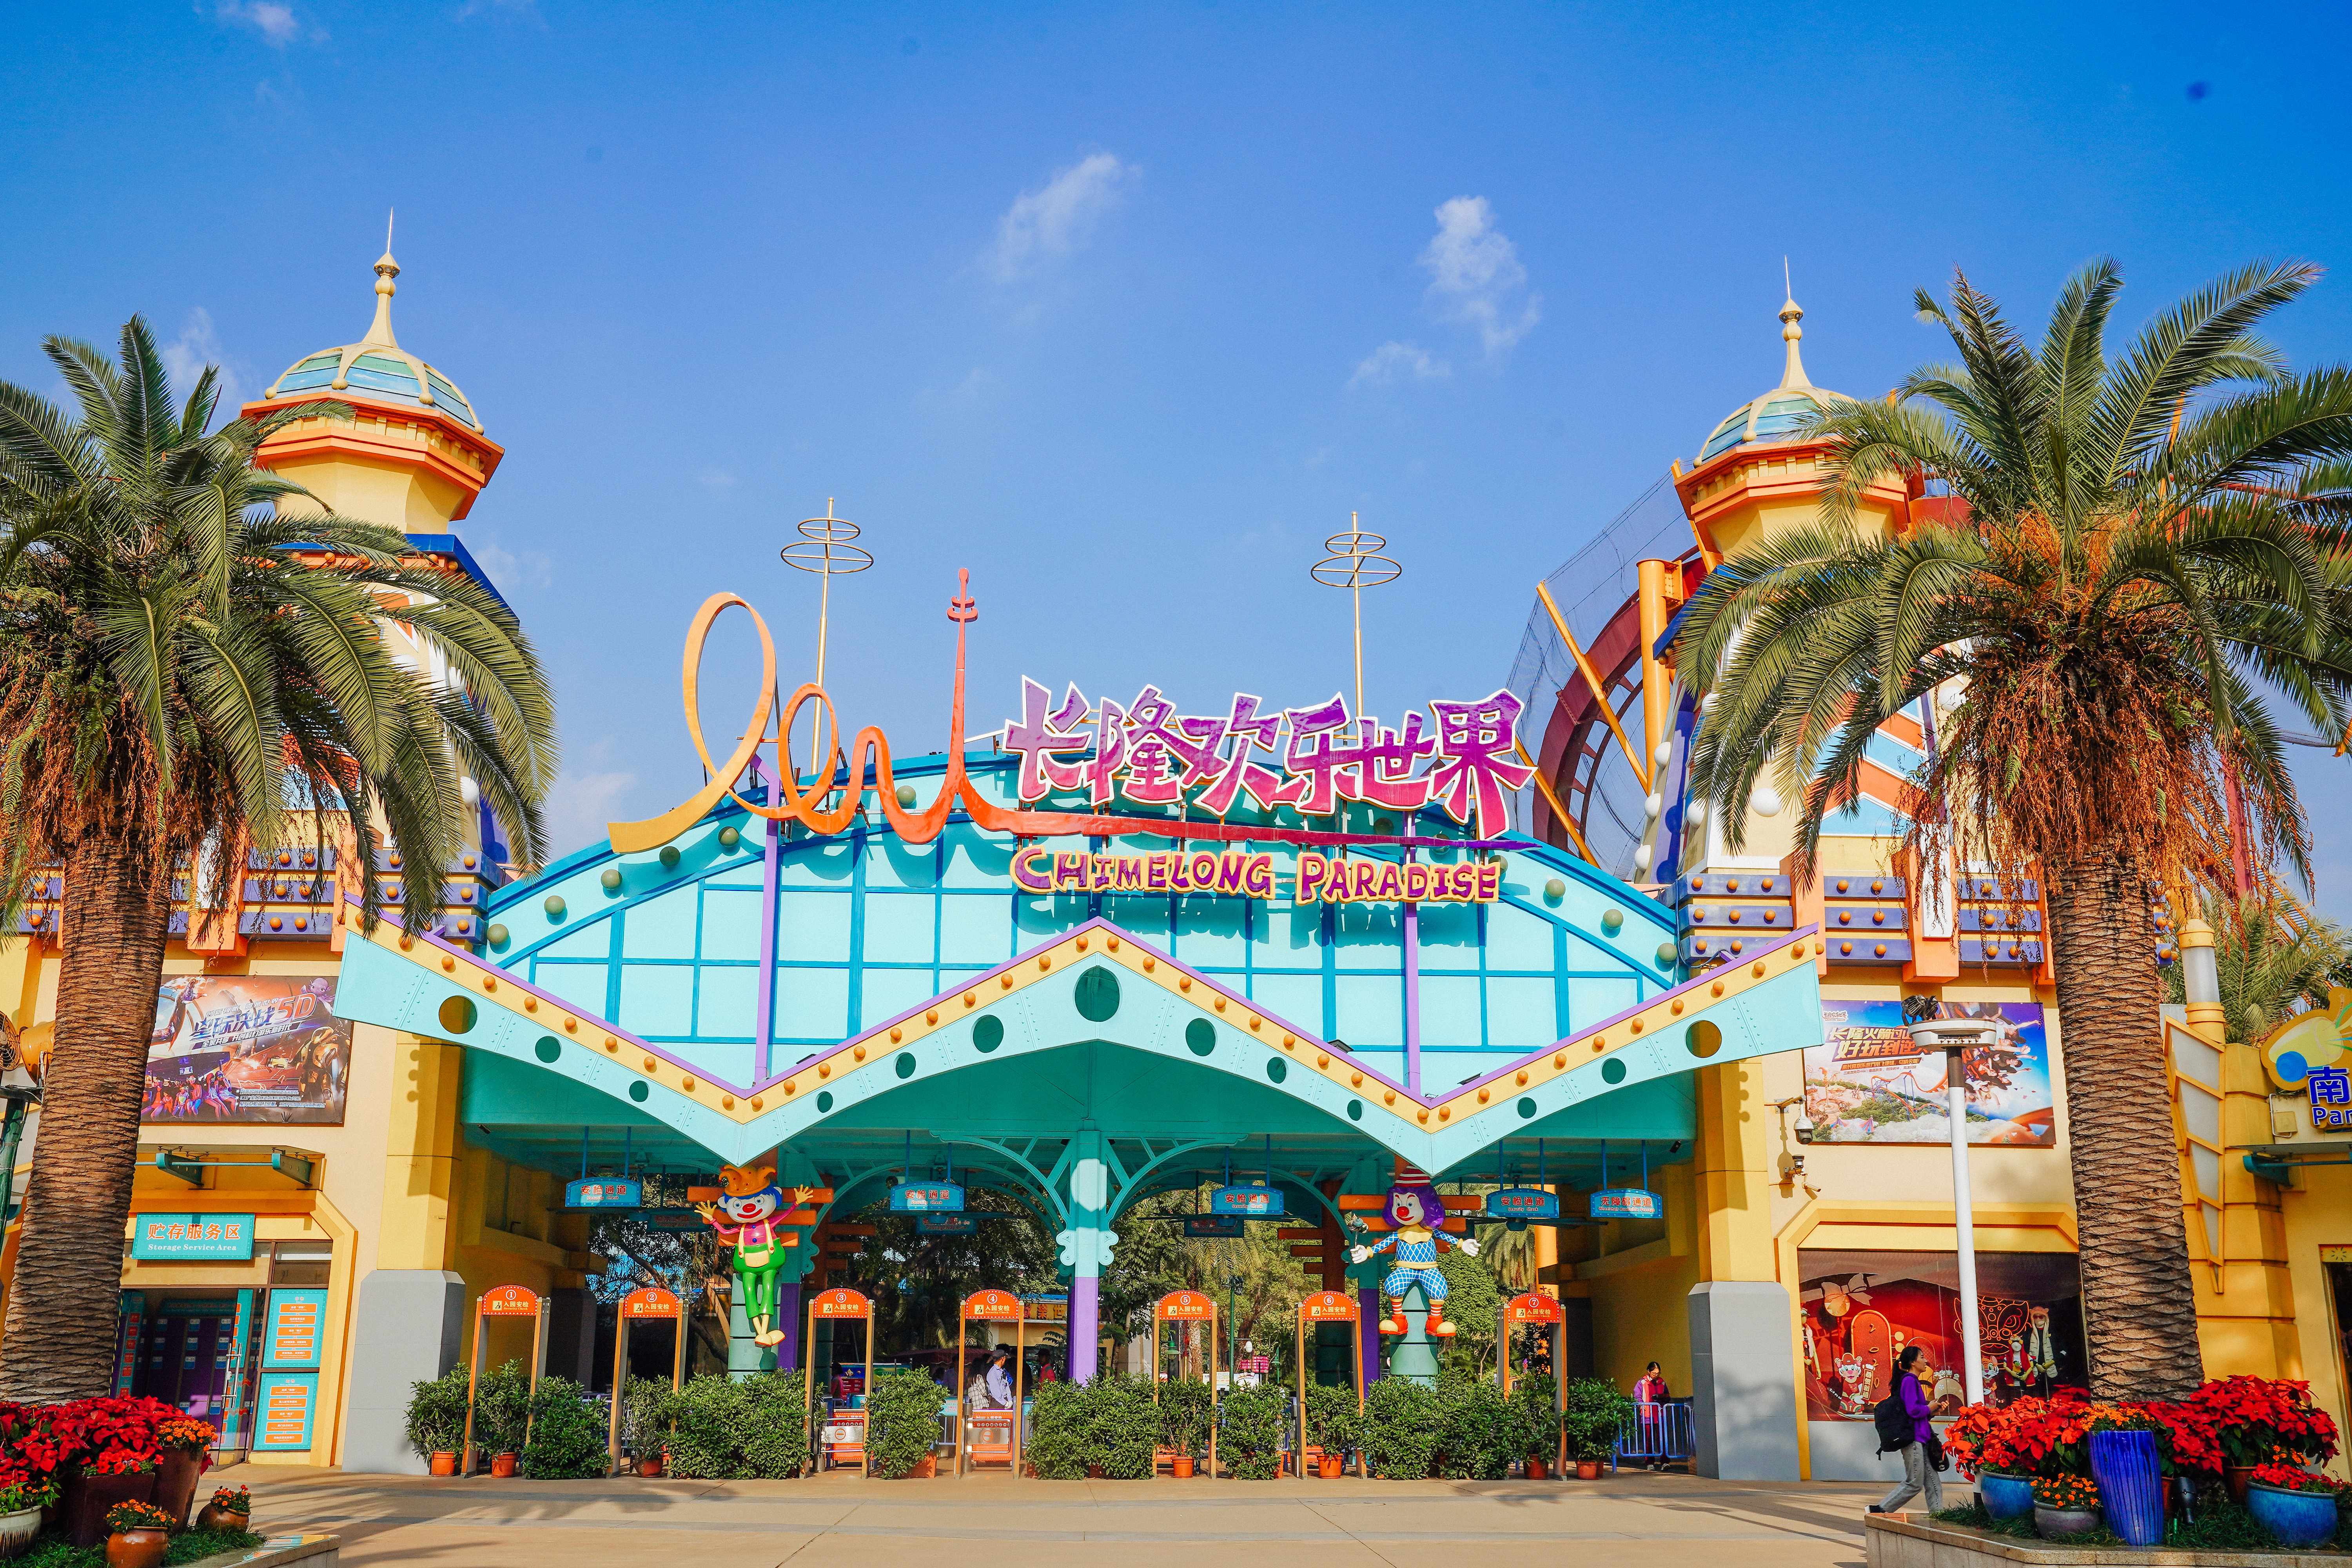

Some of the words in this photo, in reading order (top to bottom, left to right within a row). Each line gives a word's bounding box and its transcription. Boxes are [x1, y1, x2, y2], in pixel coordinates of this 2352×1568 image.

[1004, 675, 1539, 840] 长隆欢乐世界
[1009, 845, 1275, 901] CHIMELONG
[1295, 851, 1501, 906] PARADISE
[1834, 1039, 1933, 1060] 好玩到逆
[2307, 1065, 2352, 1105] 南
[581, 1184, 627, 1195] 安检通道
[905, 1189, 950, 1200] 安检通道
[1225, 1194, 1270, 1204] 安检通道
[1501, 1196, 1545, 1207] 安检通道
[1601, 1196, 1653, 1207] 无障碍通道
[147, 1223, 241, 1240] 贮存服务区
